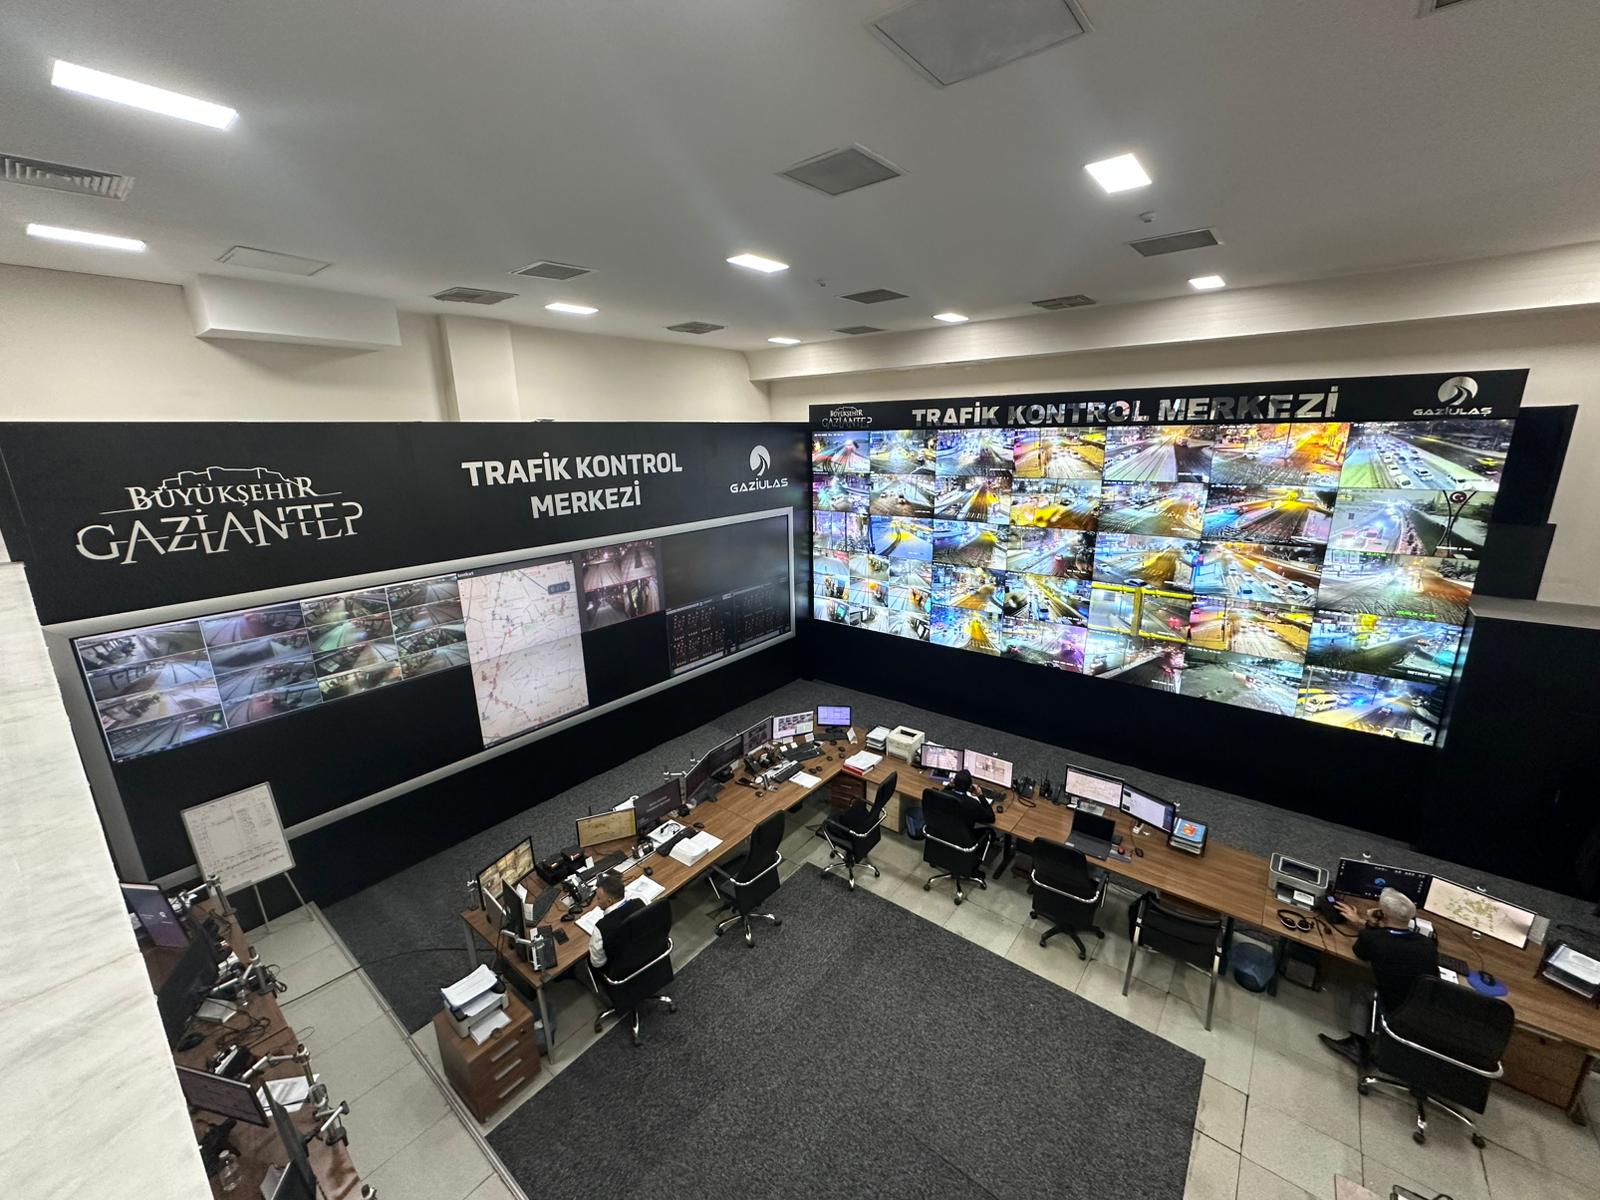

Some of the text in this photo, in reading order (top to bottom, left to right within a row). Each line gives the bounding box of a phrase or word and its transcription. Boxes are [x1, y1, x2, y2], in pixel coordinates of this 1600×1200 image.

[912, 385, 1339, 427] TRAFİK KONTROL MERKEZİ
[461, 451, 683, 486] TRAFİK KONTROL
[125, 476, 319, 510] BÜYÜKŞEHİR
[530, 480, 642, 519] MERKEZİ
